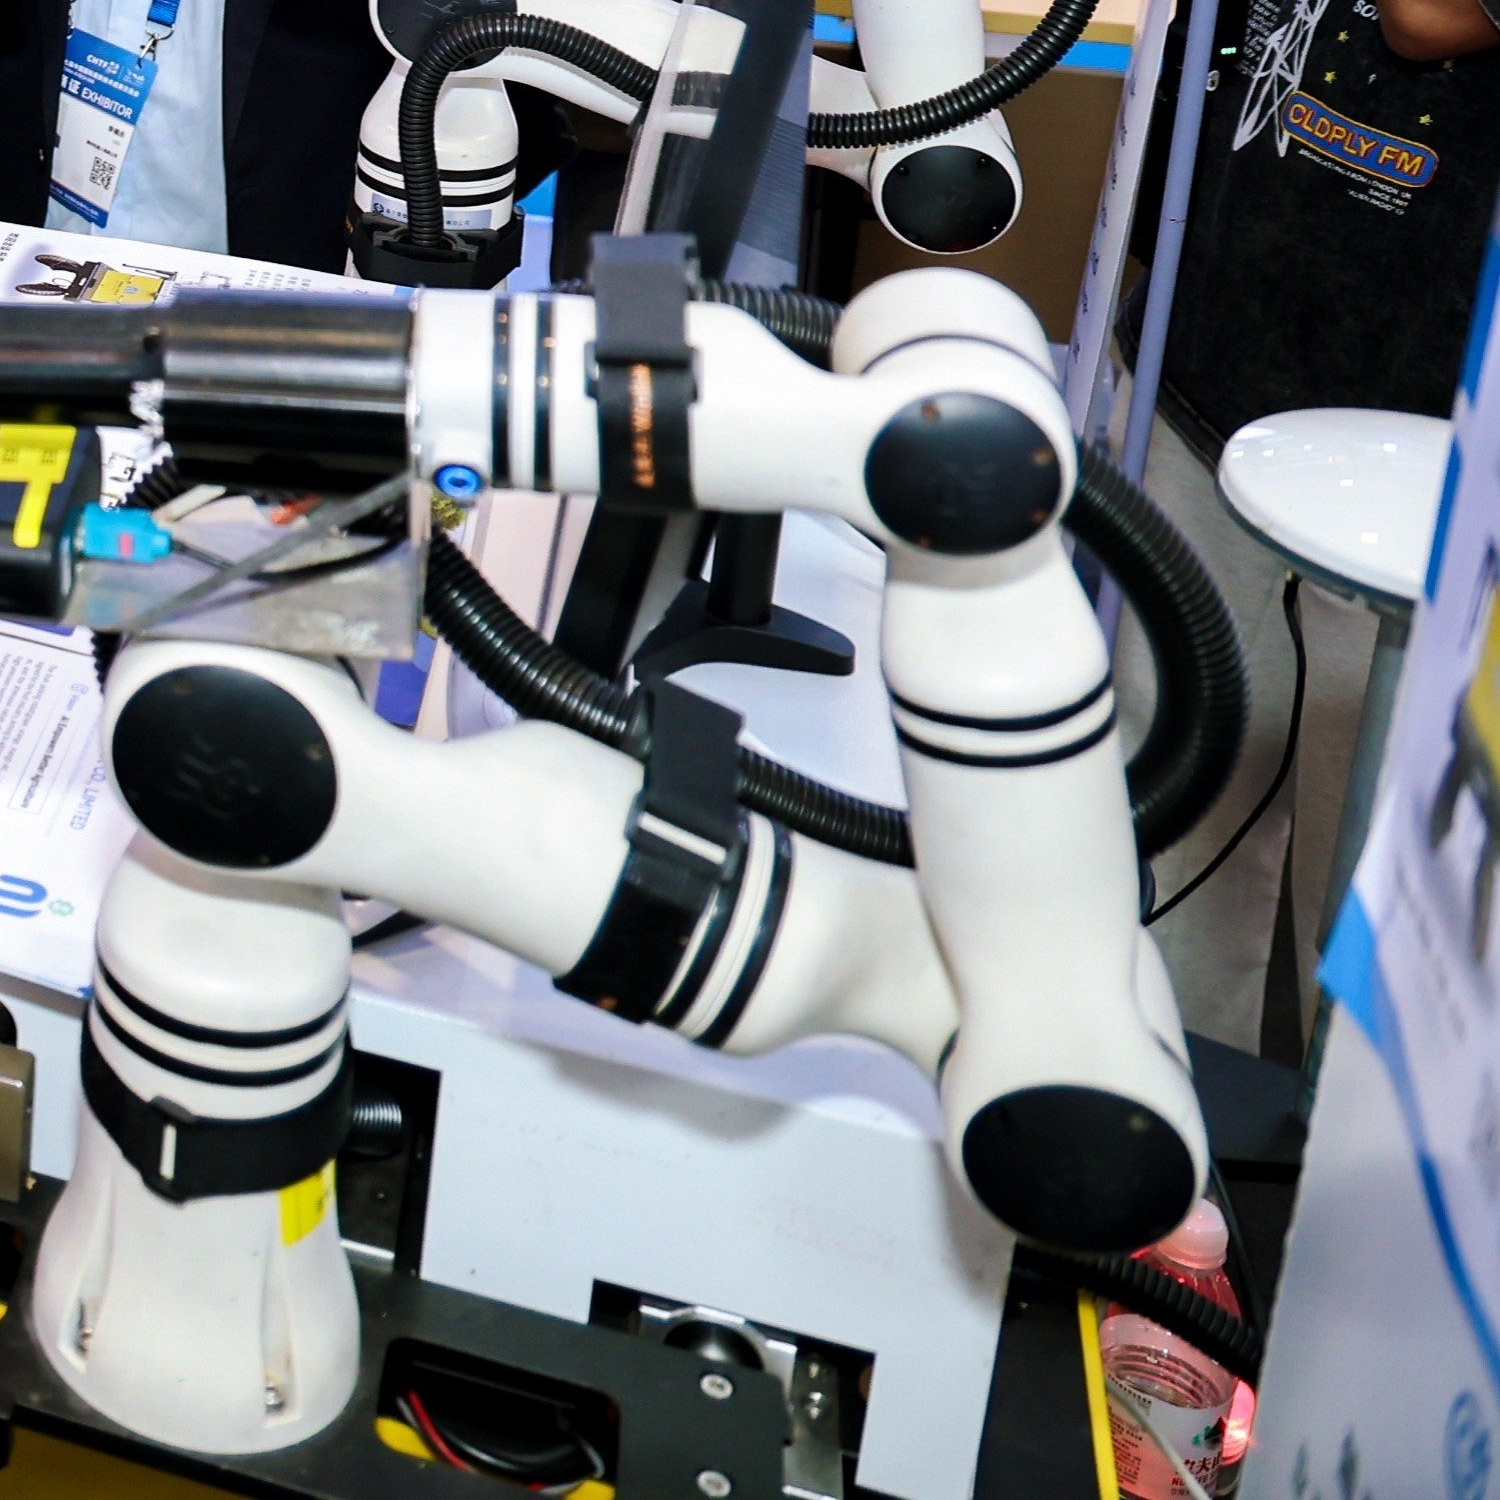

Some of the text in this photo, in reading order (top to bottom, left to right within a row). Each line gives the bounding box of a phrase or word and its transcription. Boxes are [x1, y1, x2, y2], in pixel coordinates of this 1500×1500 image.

[86, 53, 107, 70] CHTF
[81, 86, 133, 120] EXHIBITOR
[1288, 102, 1425, 177] CLDPLY FM
[67, 786, 100, 832] LIMITED
